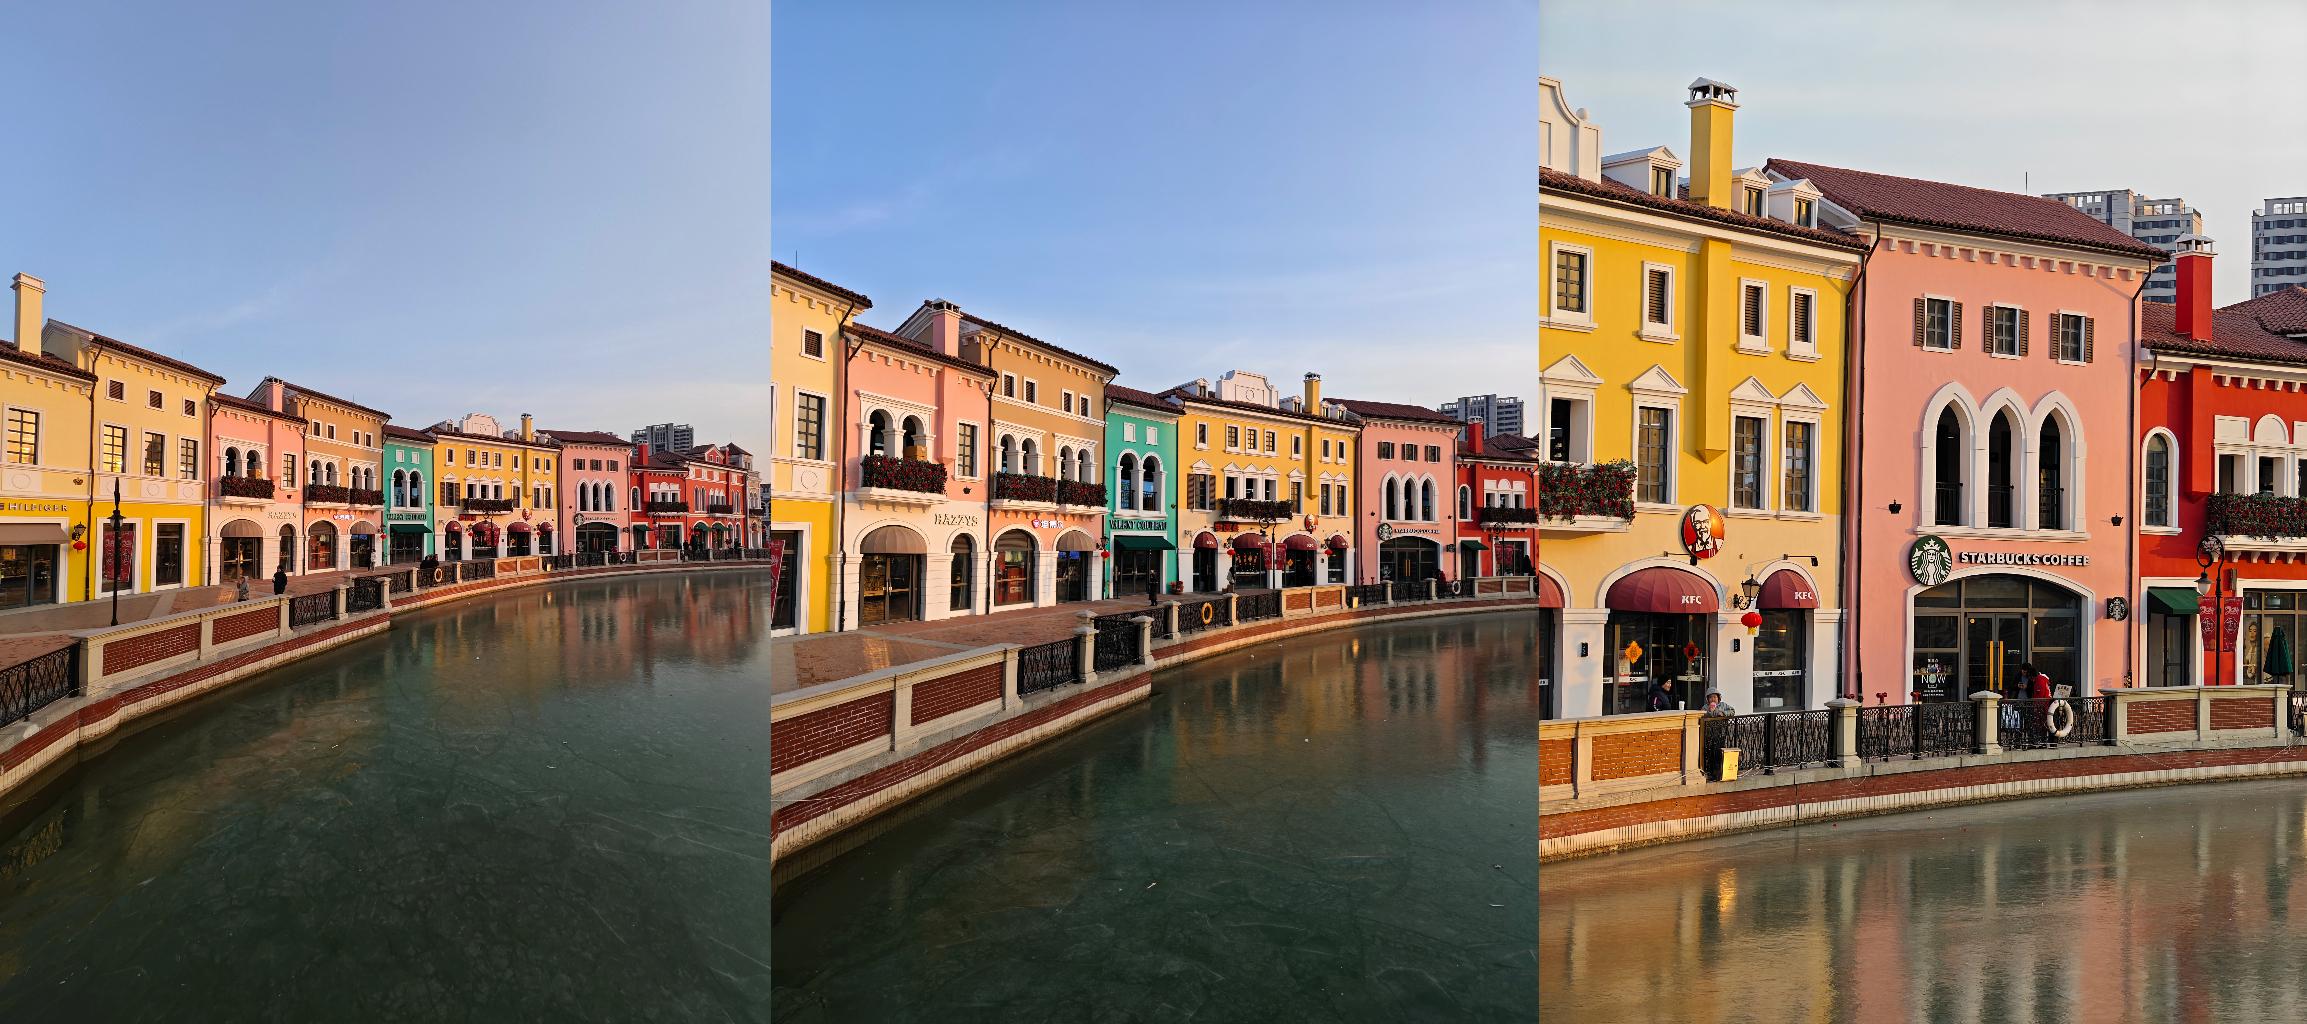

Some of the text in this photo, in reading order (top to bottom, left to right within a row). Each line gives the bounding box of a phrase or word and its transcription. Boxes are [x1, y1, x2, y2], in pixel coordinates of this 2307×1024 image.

[8, 502, 68, 512] HILFIGER
[1959, 551, 2090, 567] STARBUCKS COFFEE
[1681, 595, 1702, 605] KFC
[1794, 591, 1813, 600] KFC
